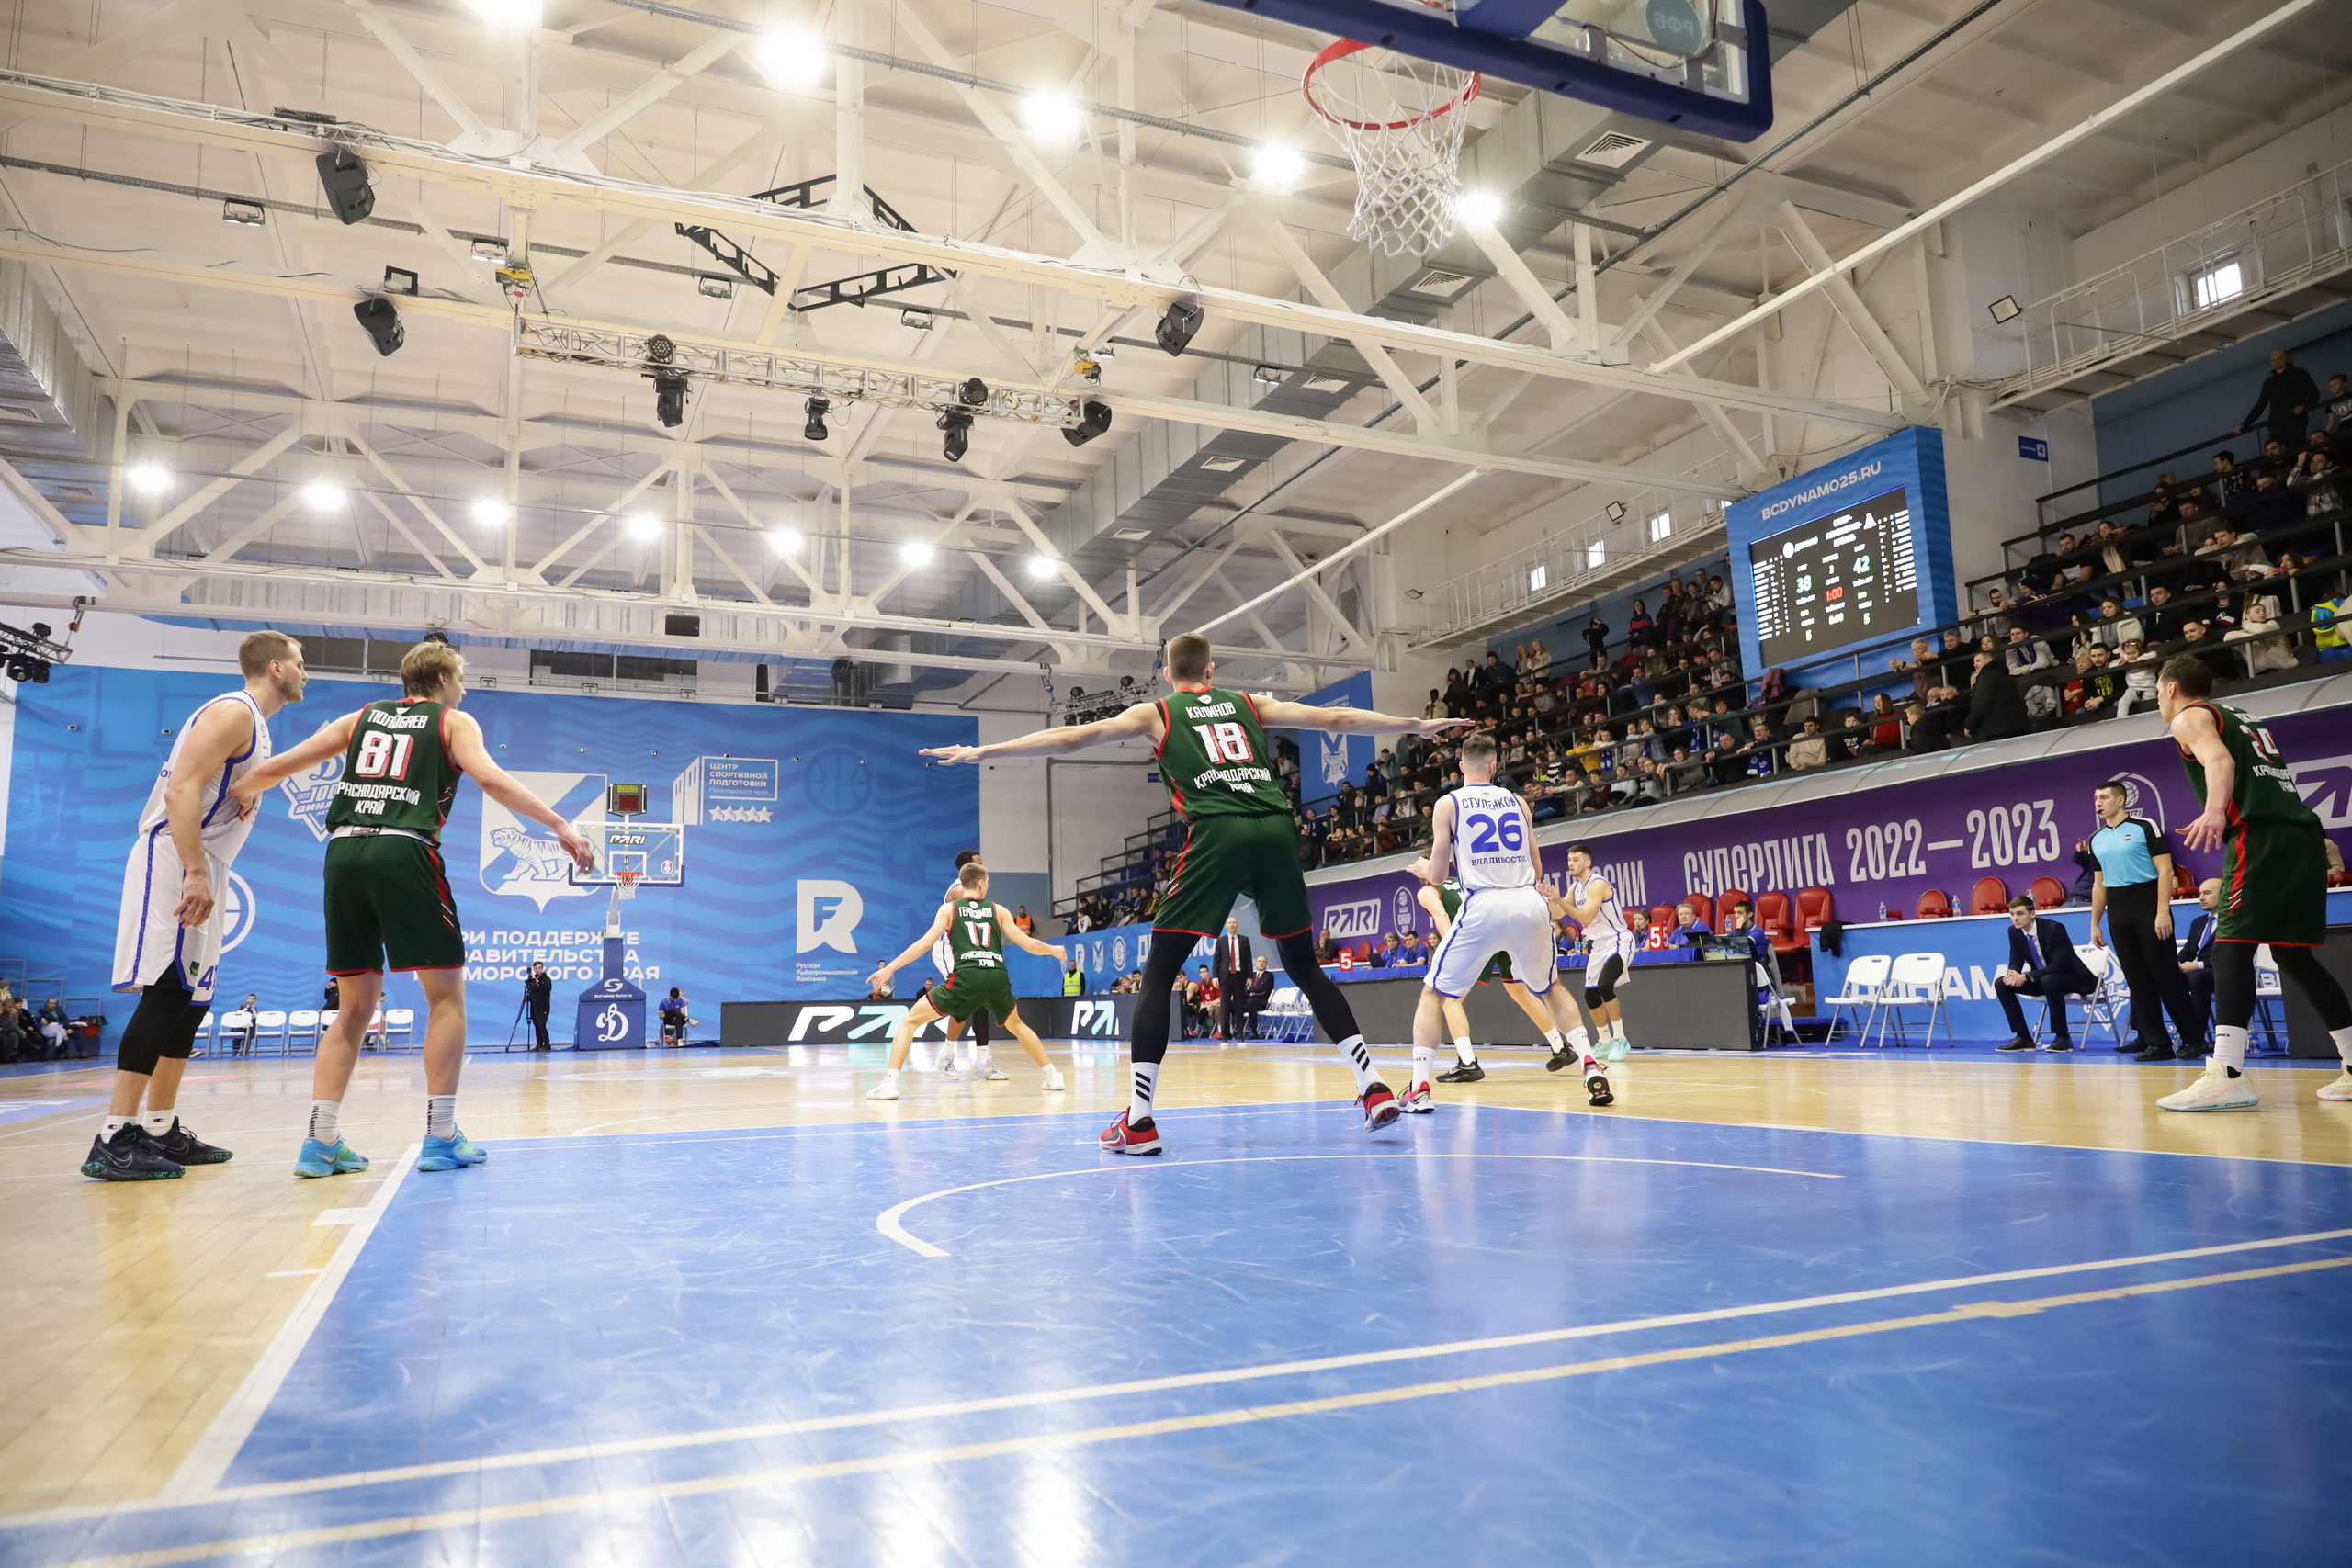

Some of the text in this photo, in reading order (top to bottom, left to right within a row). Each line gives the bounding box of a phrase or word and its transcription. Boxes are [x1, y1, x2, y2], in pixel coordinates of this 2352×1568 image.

[1761, 460, 1882, 521] BCDYNAMO25.RU
[1828, 564, 1835, 574] 2
[1852, 555, 1871, 574] 42
[1796, 574, 1812, 593] 38
[1825, 586, 1843, 602] 1:00
[1863, 612, 1871, 625] 5
[1805, 629, 1812, 641] 5
[1185, 701, 1237, 719] КАЛИНОВ
[1192, 722, 1254, 765] 18
[355, 730, 413, 781] 81
[709, 762, 739, 771] ЦЕНТР
[709, 771, 768, 780] СПОРТИВНОЙ
[709, 779, 767, 787] ПОДГОТОВКИ
[336, 781, 420, 806] РАСНОДАРСКИЙ
[294, 801, 332, 814] ДИНА
[354, 799, 385, 816] КРАЙ
[1462, 795, 1517, 811] СТУЛЕНКОВ
[609, 834, 646, 845] PARI
[1465, 812, 1523, 854] 26
[1327, 904, 1377, 933] PARI
[964, 921, 992, 947] 17
[1650, 926, 1661, 948] 5
[465, 948, 640, 964] АВИТЕЛЬСТА
[1340, 953, 1351, 970] 5
[600, 965, 660, 980] АЯ
